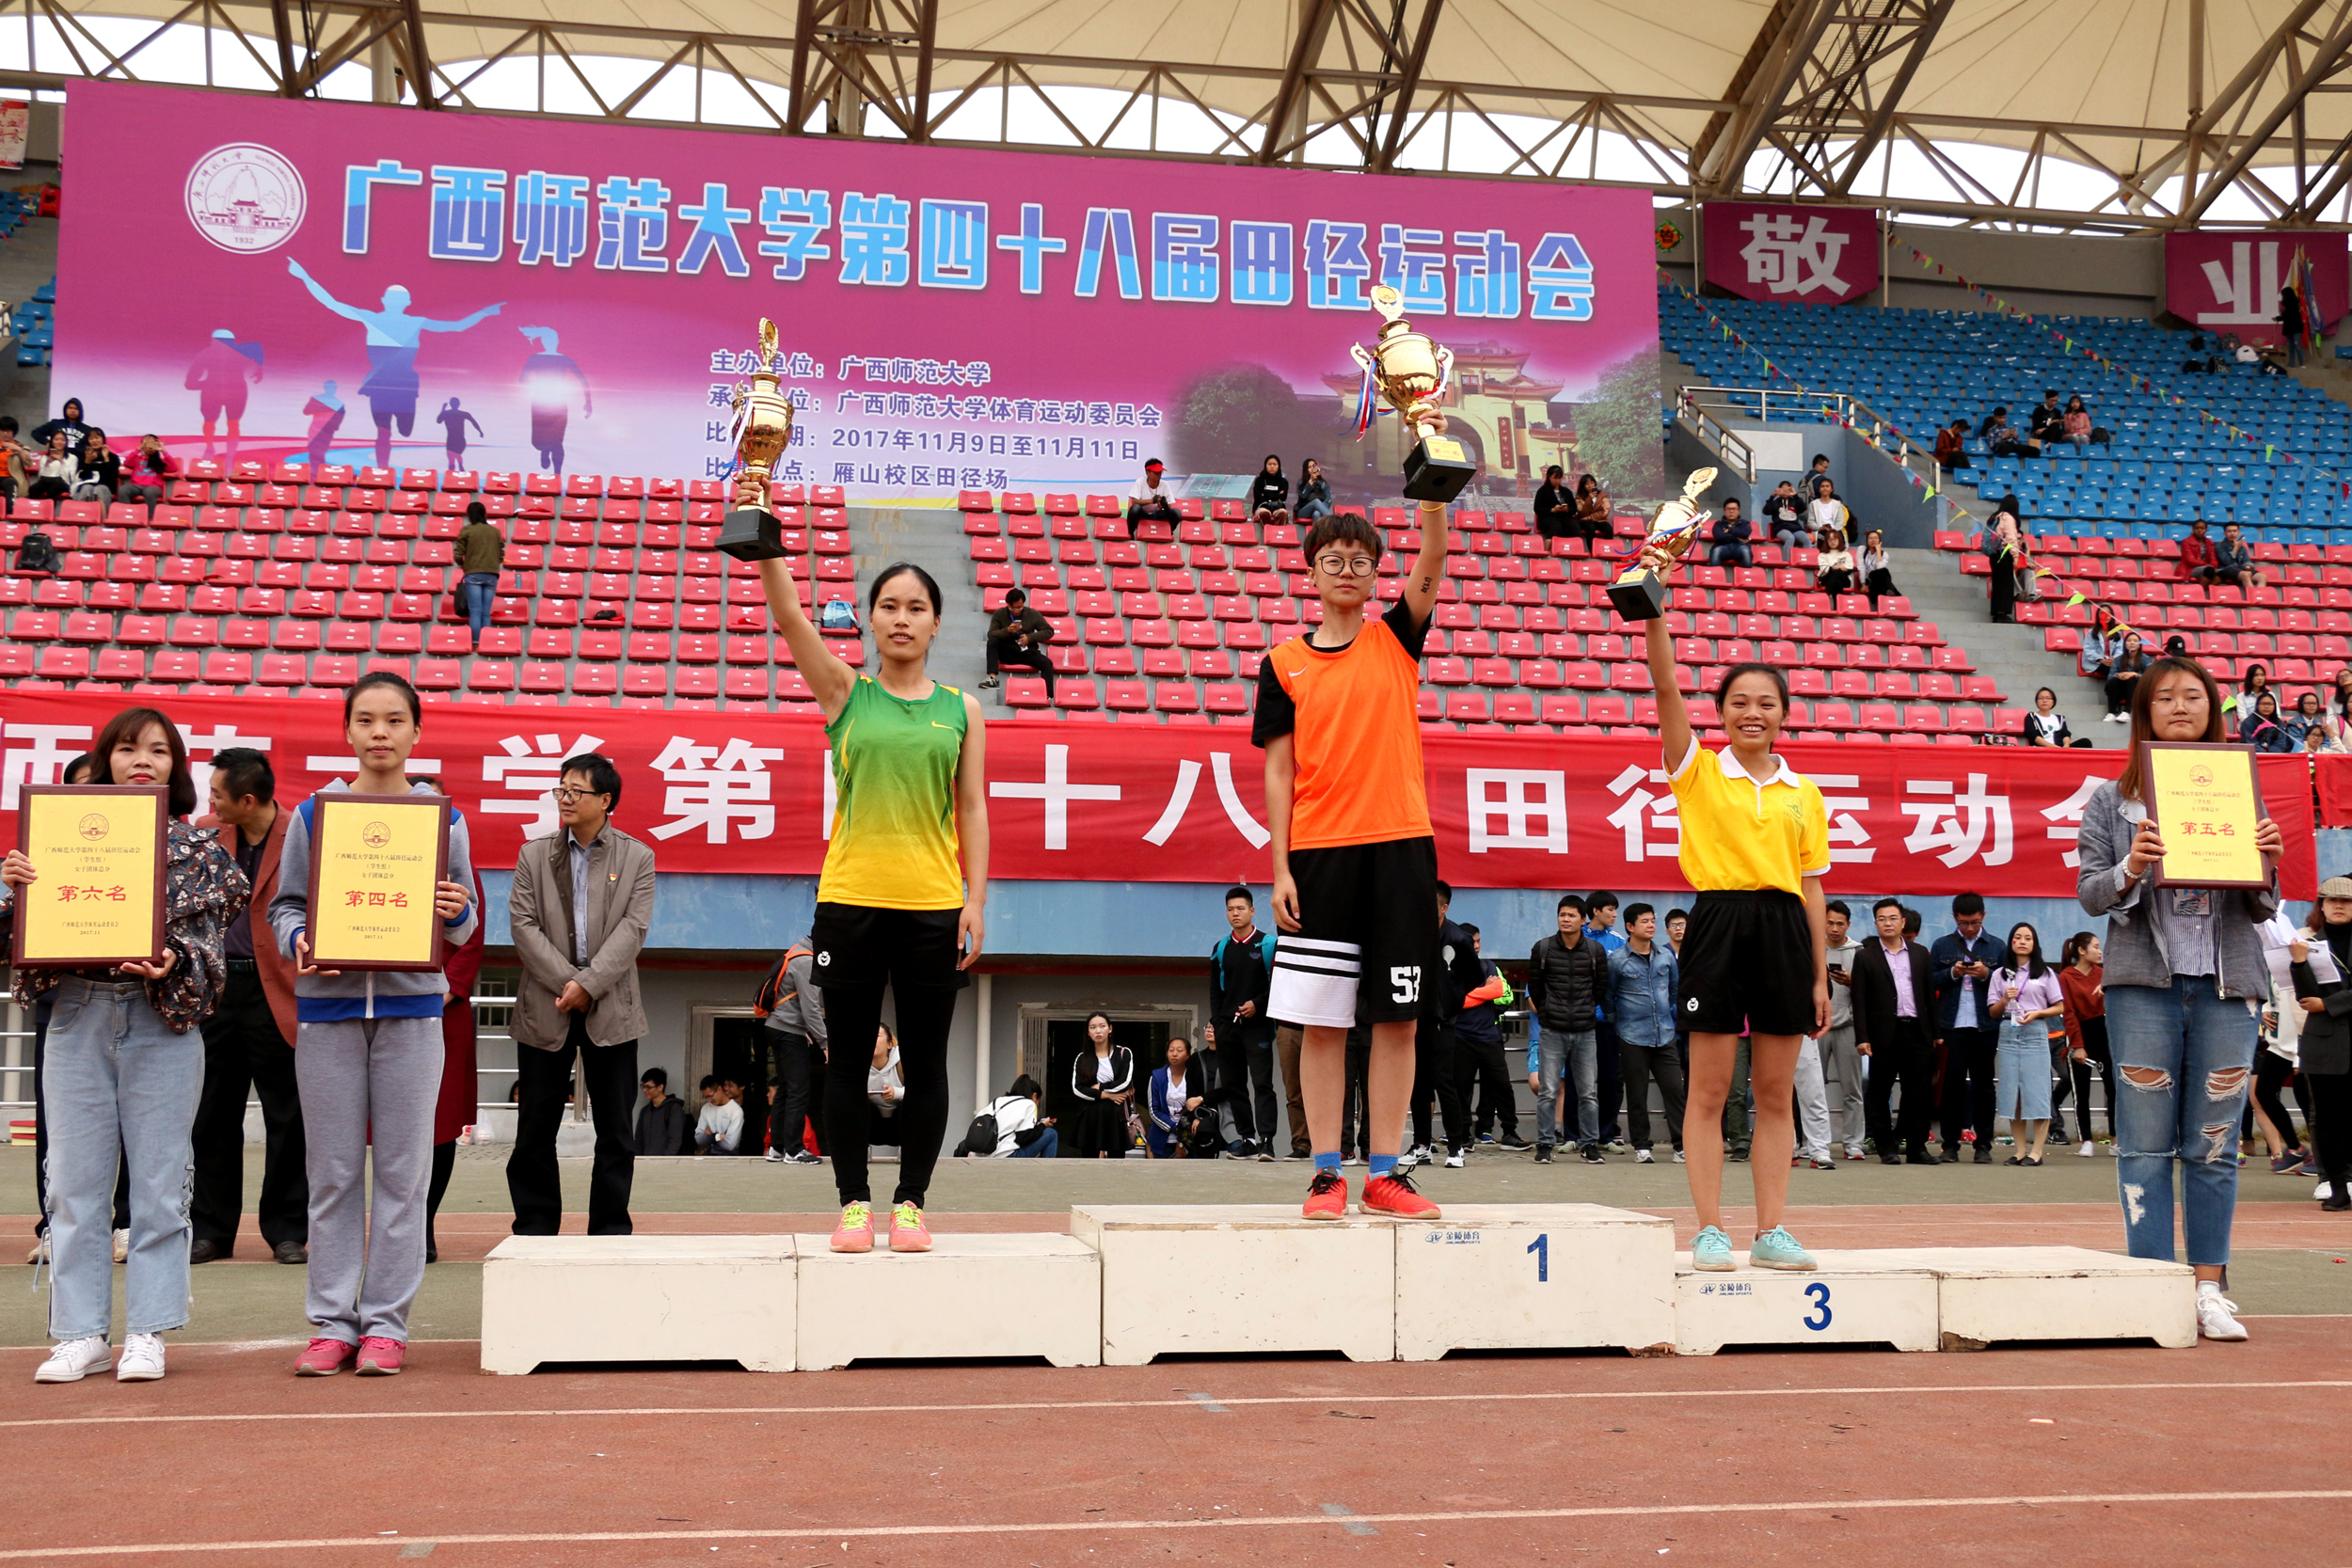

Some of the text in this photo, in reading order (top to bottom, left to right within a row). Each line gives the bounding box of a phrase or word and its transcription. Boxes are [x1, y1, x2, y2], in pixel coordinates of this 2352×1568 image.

[342, 159, 1595, 322] 广西师范大学第四十八届田径运动会
[1739, 213, 1851, 296] 敬
[2198, 242, 2313, 325] 业
[707, 385, 1163, 429] 承位：广西师范大学体育运动委员会
[706, 420, 1139, 462] 比期：2017年11月9日至11月11日
[705, 455, 1009, 491] 比点：雁山校区田径场
[2180, 821, 2235, 836] 第五名
[57, 884, 126, 902] 第六名
[345, 890, 408, 908] 第四名
[1446, 1230, 1480, 1240] 金陵体育
[1527, 1234, 1548, 1282] 1
[1719, 1283, 1752, 1291] 金陵体育
[1804, 1282, 1833, 1331] 3
